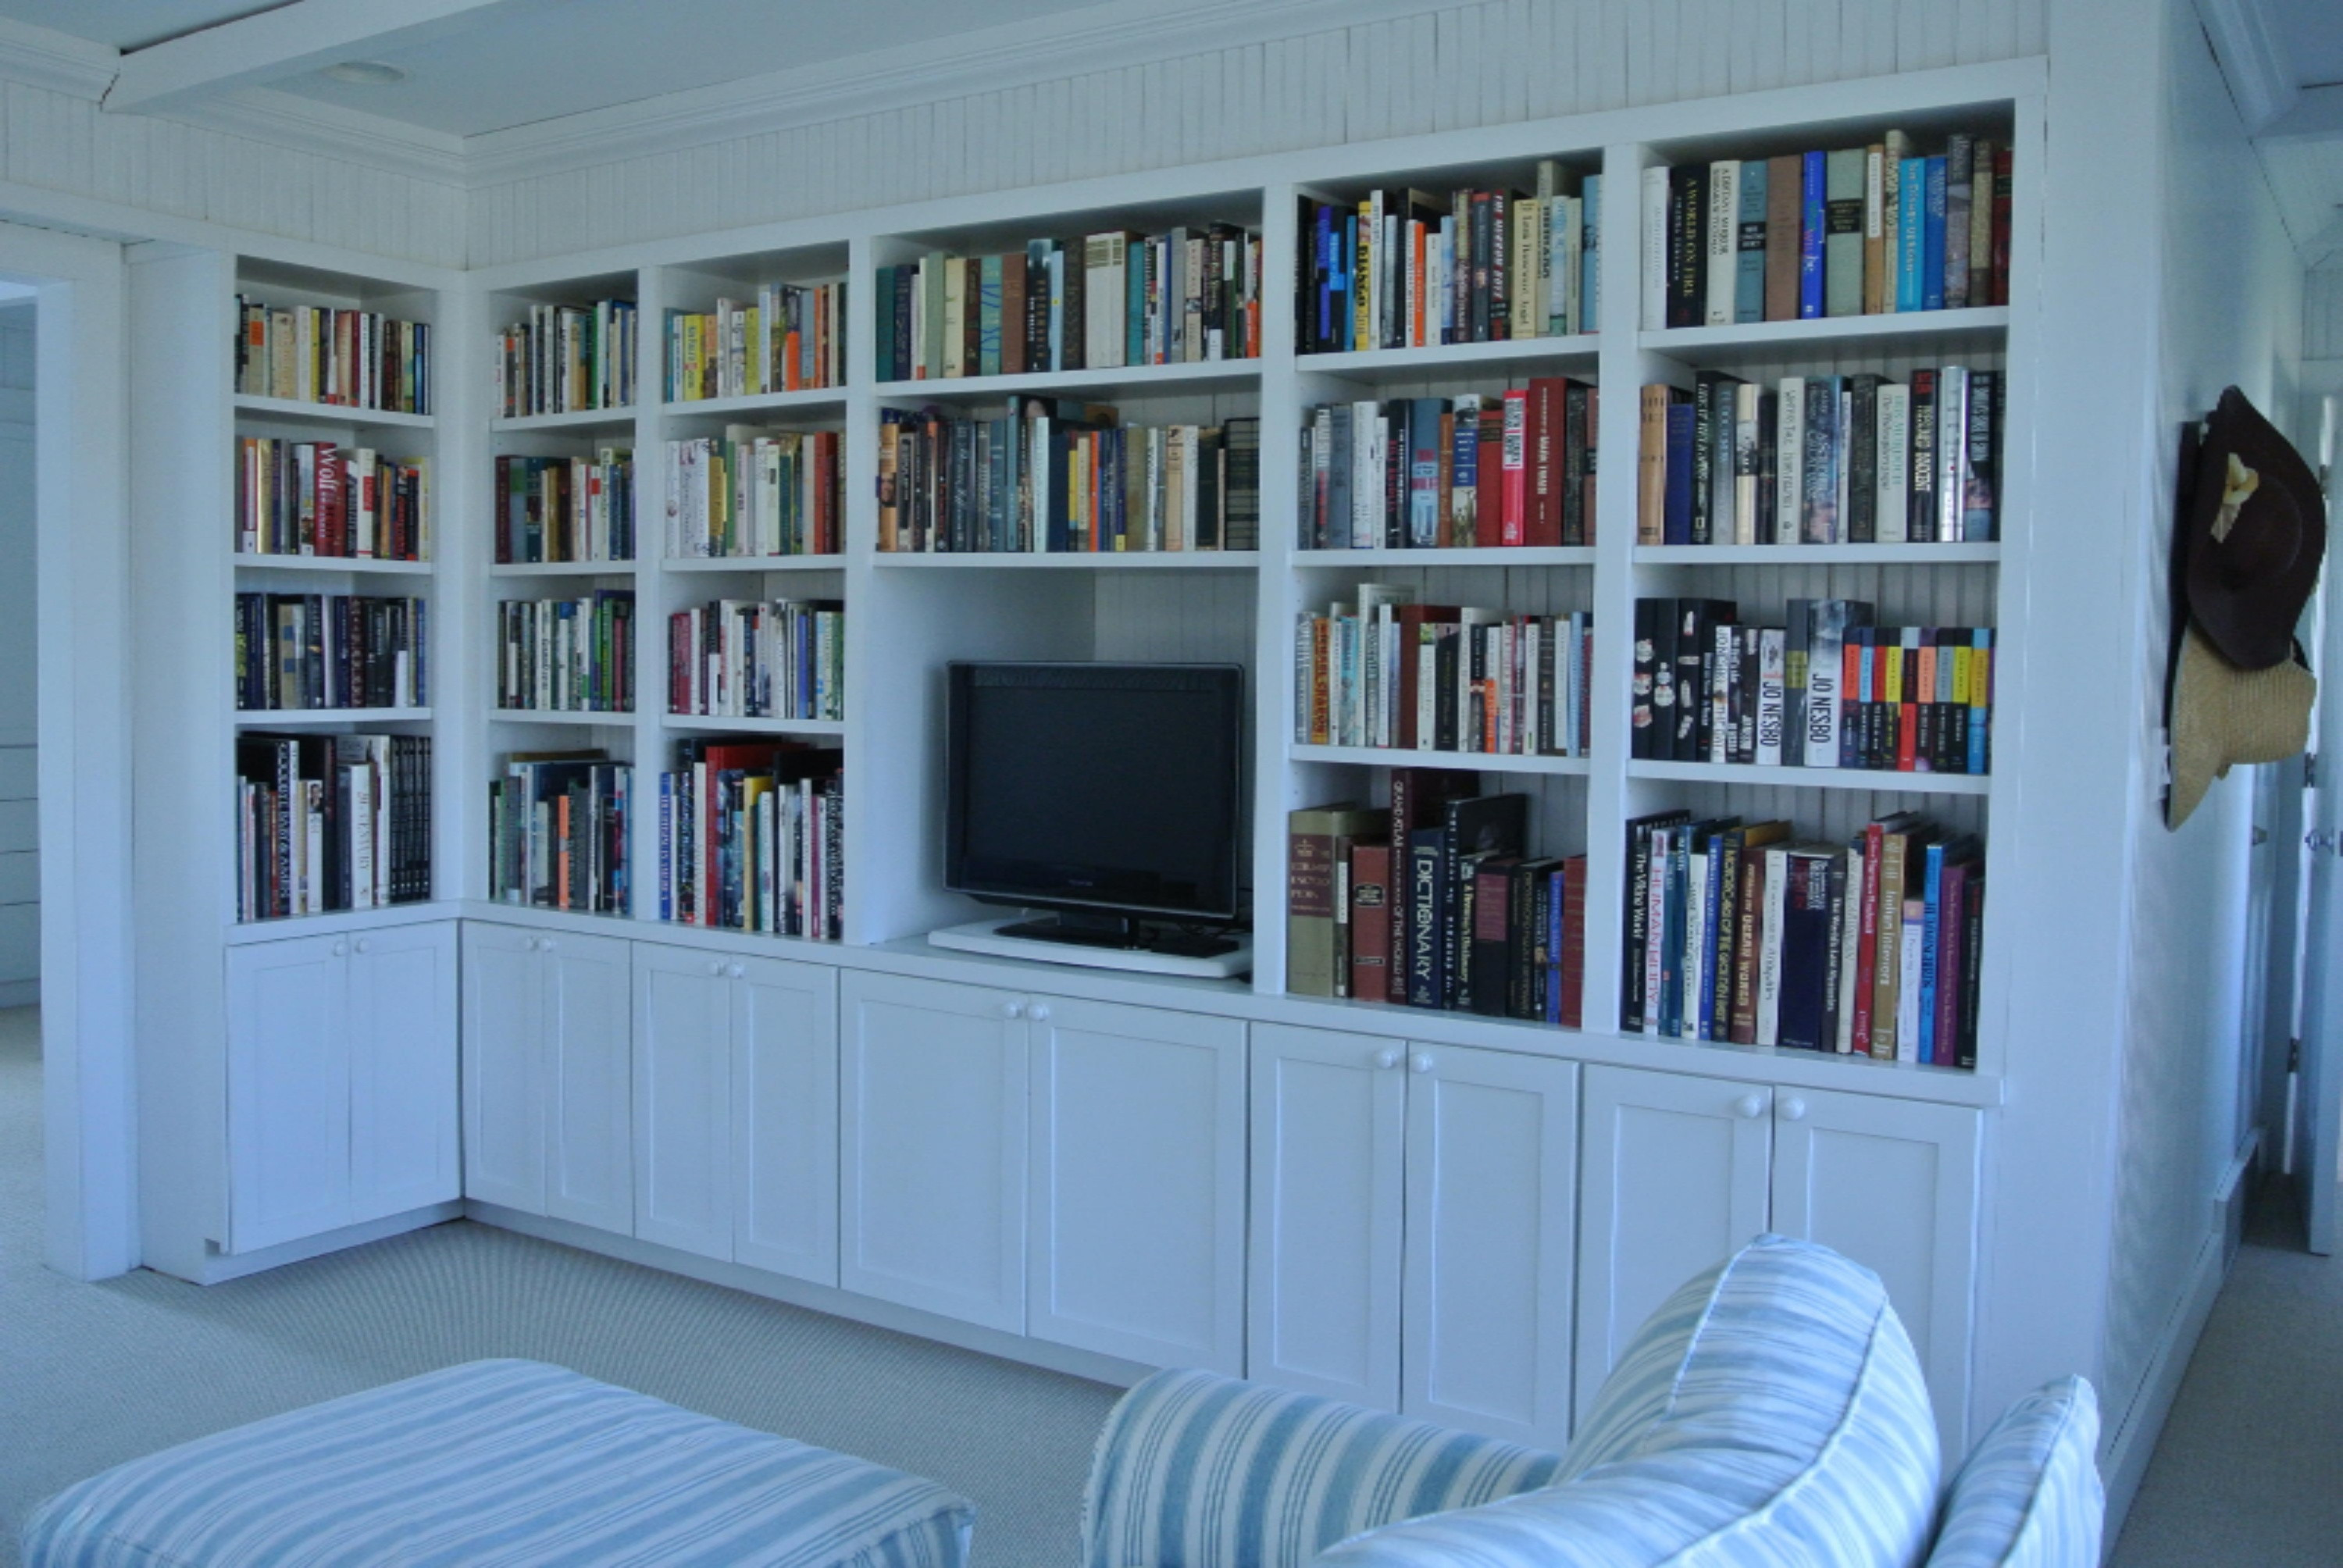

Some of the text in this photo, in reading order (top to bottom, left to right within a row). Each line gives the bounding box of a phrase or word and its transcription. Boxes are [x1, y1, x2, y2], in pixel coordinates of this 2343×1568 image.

[1681, 177, 1698, 298] A WORLD ON FIRE
[1538, 436, 1550, 463] MARK
[1892, 395, 1904, 486] IRIS MURDOCH
[1760, 682, 1781, 747] JO NESBO
[1809, 673, 1835, 743] JO NESBO
[1393, 781, 1404, 974] GRAND ATLAS OF THE WORLD
[1632, 874, 1646, 906] Viking
[1635, 852, 1646, 872] The
[1721, 850, 1735, 918] MOTORCARS
[1414, 859, 1433, 982] DICTIONARY
[1524, 871, 1532, 928] CROSSWORD
[1633, 908, 1645, 939] World
[1833, 897, 1843, 913] The
[1646, 868, 1664, 1007] HUMAN BODY
[1830, 915, 1842, 947] World's
[1879, 890, 1898, 985] Indian Interiors
[1717, 953, 1731, 998] GOLDEN
[1825, 969, 1838, 1012] Mysteries
